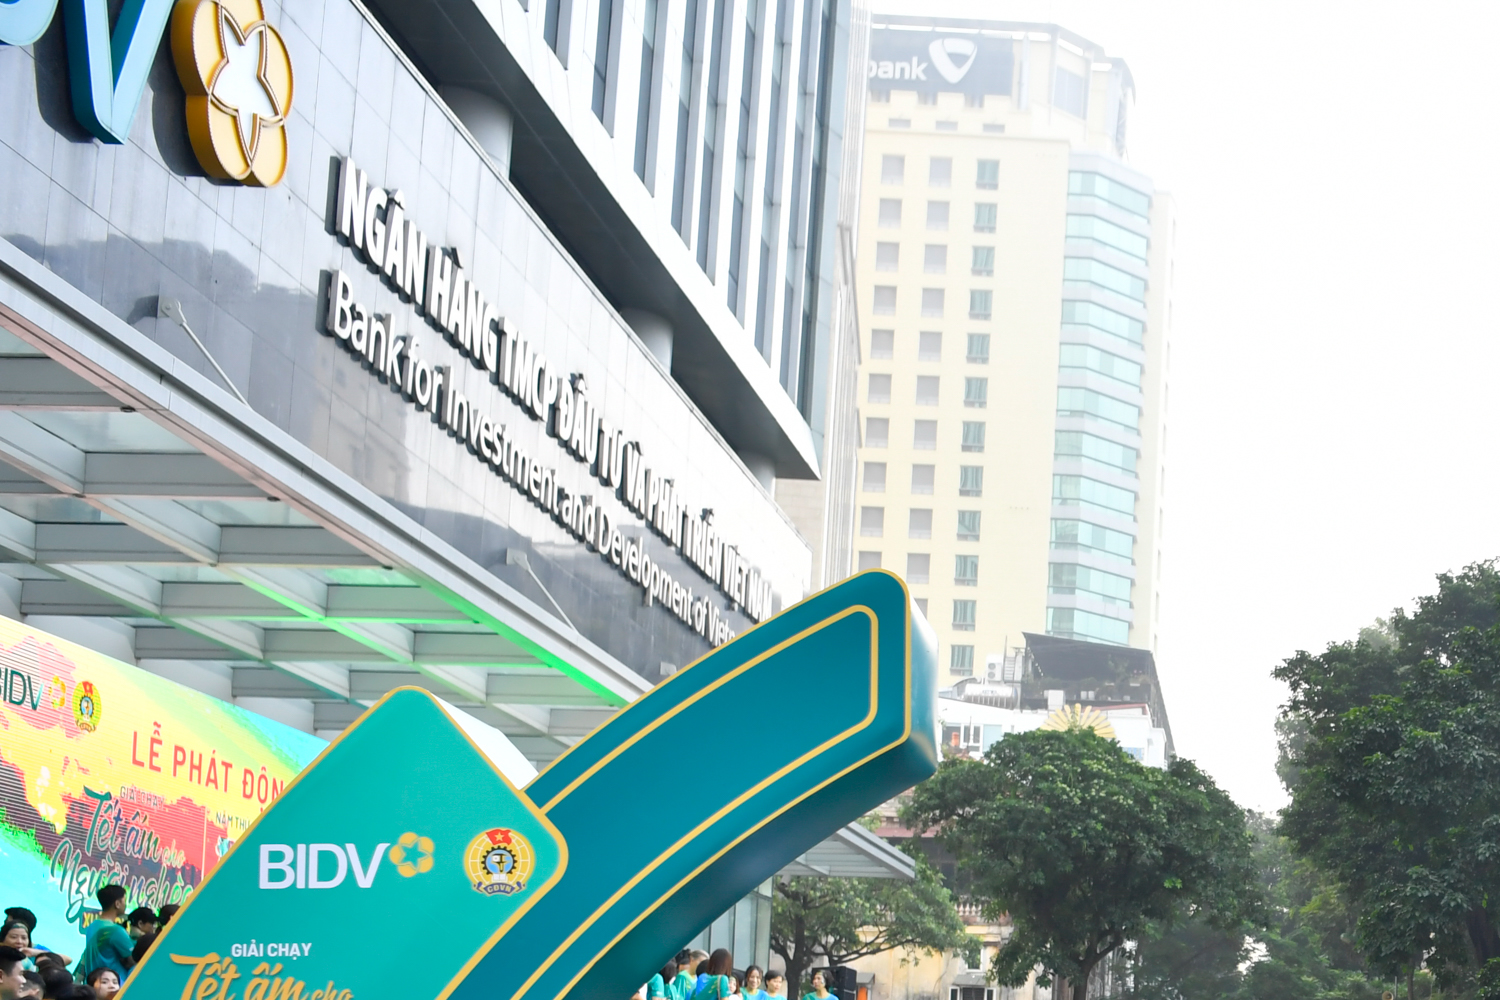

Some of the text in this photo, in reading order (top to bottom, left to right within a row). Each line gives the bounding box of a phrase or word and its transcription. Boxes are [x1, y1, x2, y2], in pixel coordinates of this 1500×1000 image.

[340, 156, 428, 306] NGÂN
[429, 245, 499, 374] HÀNG
[502, 316, 558, 423] TMCP
[749, 567, 773, 622] NAM
[333, 269, 404, 387] Bank
[406, 335, 444, 415] for
[446, 365, 560, 516] Investment
[561, 490, 597, 544] and
[598, 506, 693, 627] Development
[694, 595, 710, 637] of
[0, 667, 45, 711] IDV
[131, 720, 284, 813] LỄ PHÁT ĐỘN
[258, 842, 391, 890] BIDV
[230, 939, 312, 960] GIẢI CHẠY
